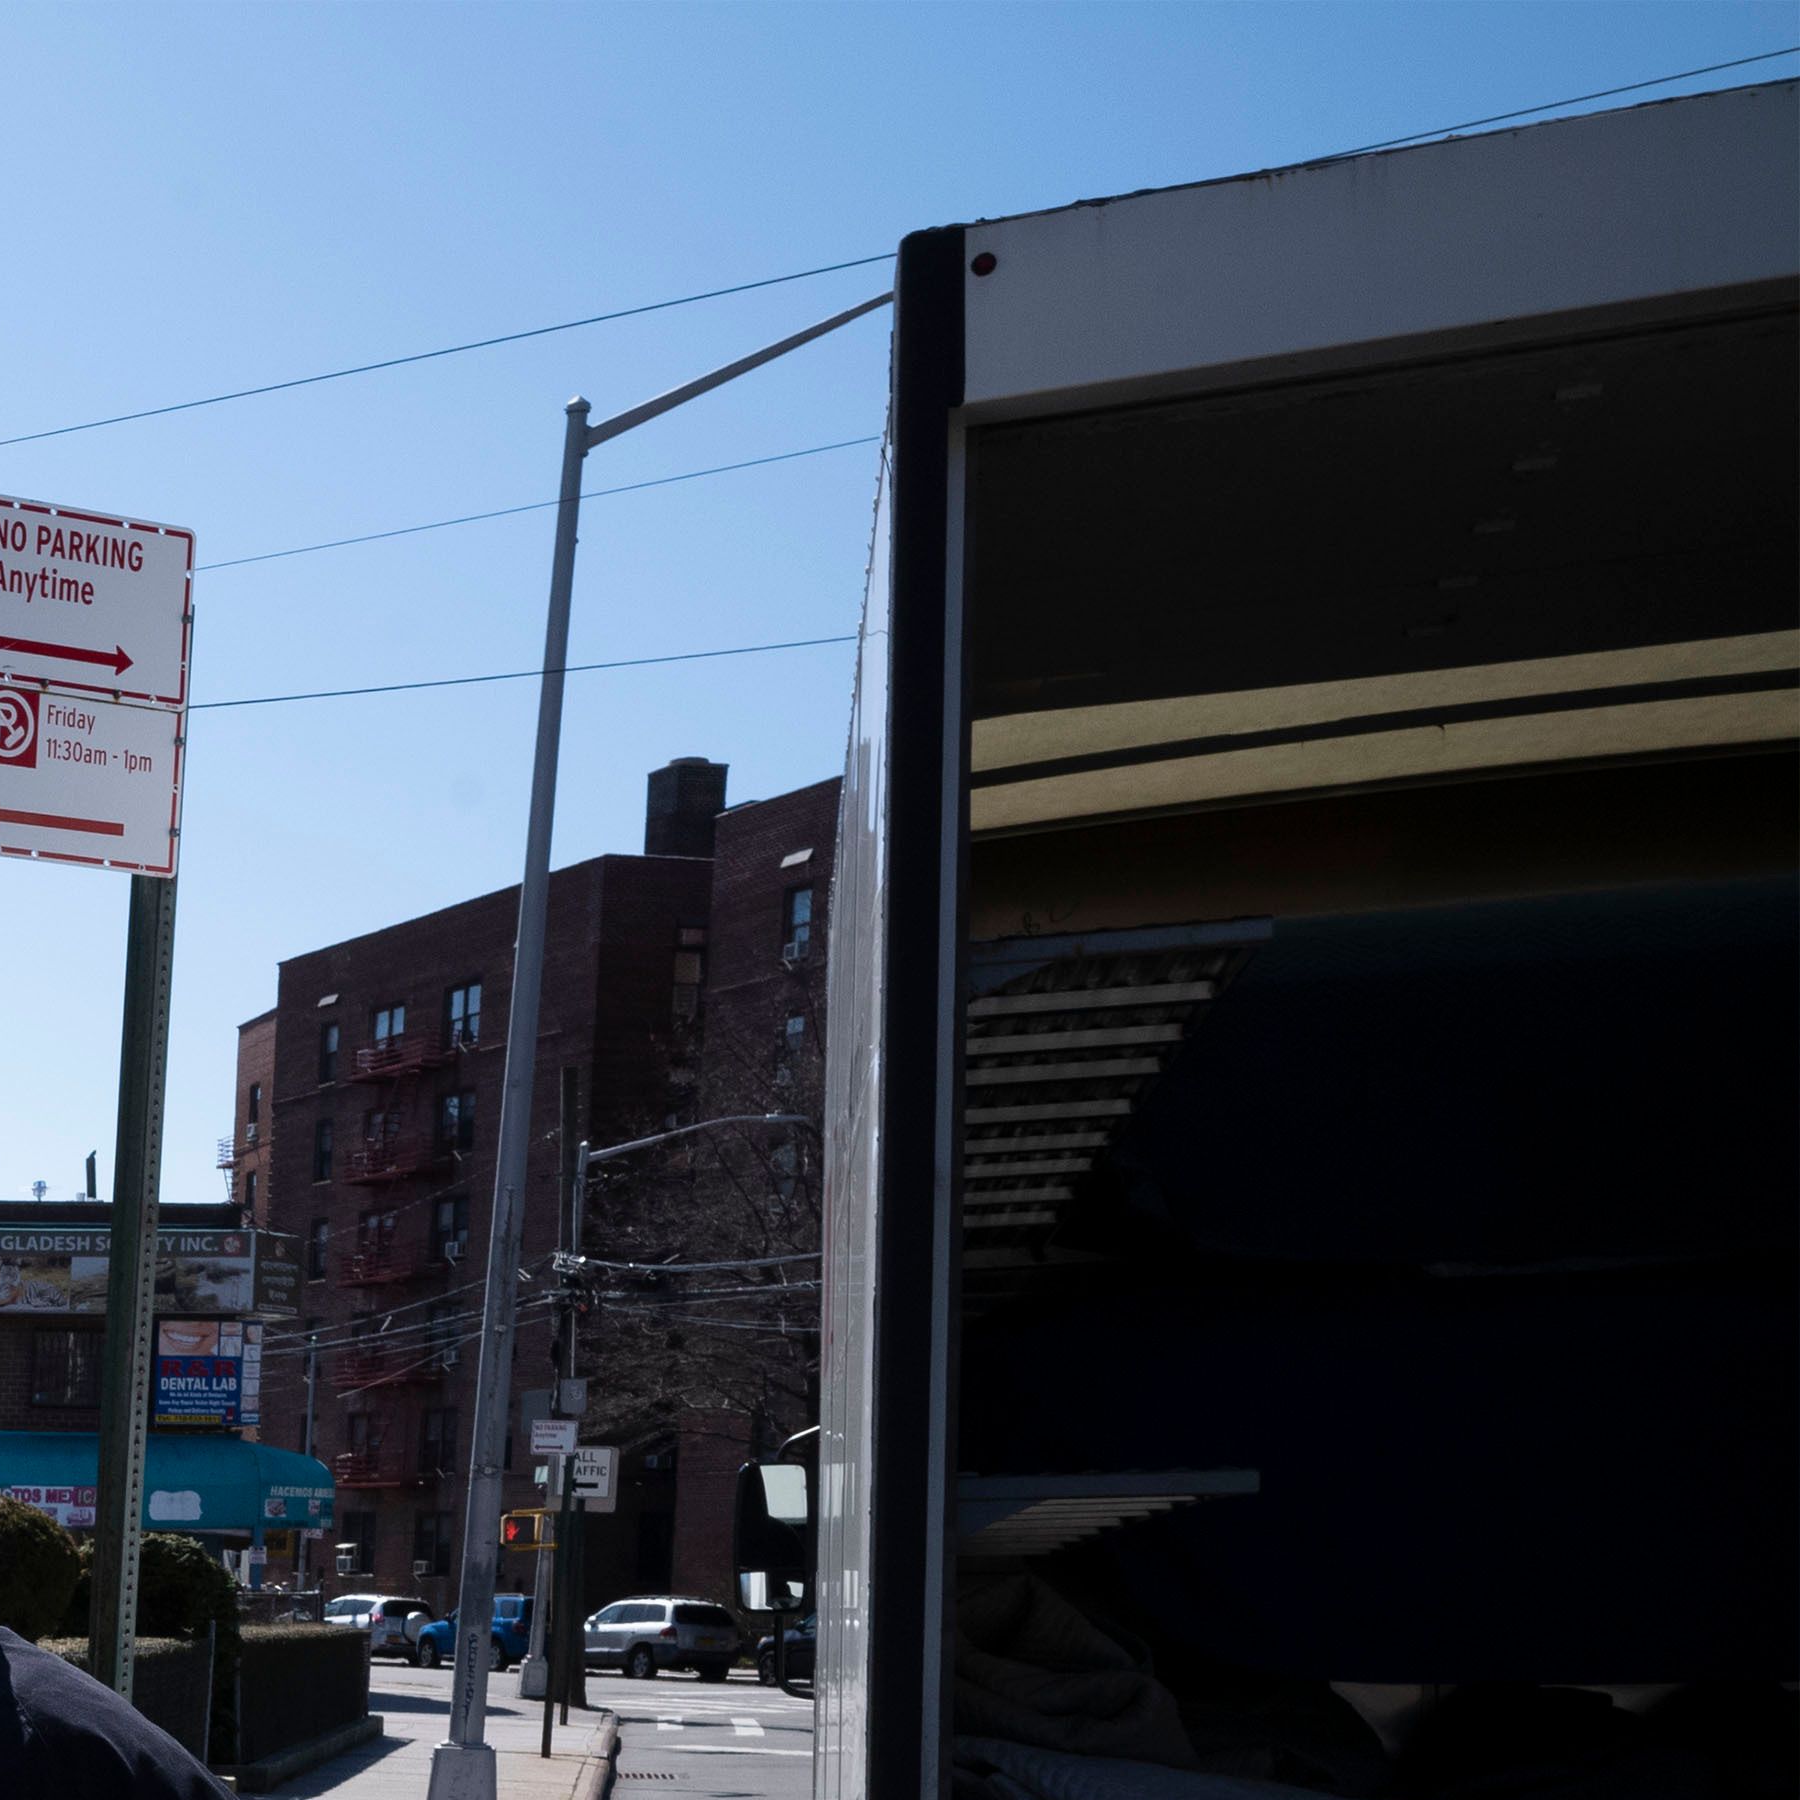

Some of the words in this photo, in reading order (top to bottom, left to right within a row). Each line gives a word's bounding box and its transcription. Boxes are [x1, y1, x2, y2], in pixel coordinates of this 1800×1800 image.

[35, 526, 145, 573] PARKING
[47, 704, 97, 736] Friday
[46, 739, 108, 766] 11:30am
[123, 749, 153, 774] 1pm
[179, 1236, 220, 1252] INC.
[161, 1359, 183, 1377] R
[160, 1377, 210, 1391] DENTAL
[212, 1377, 238, 1392] LAB
[574, 1450, 598, 1463] ALL
[568, 1465, 608, 1477] AFFIC
